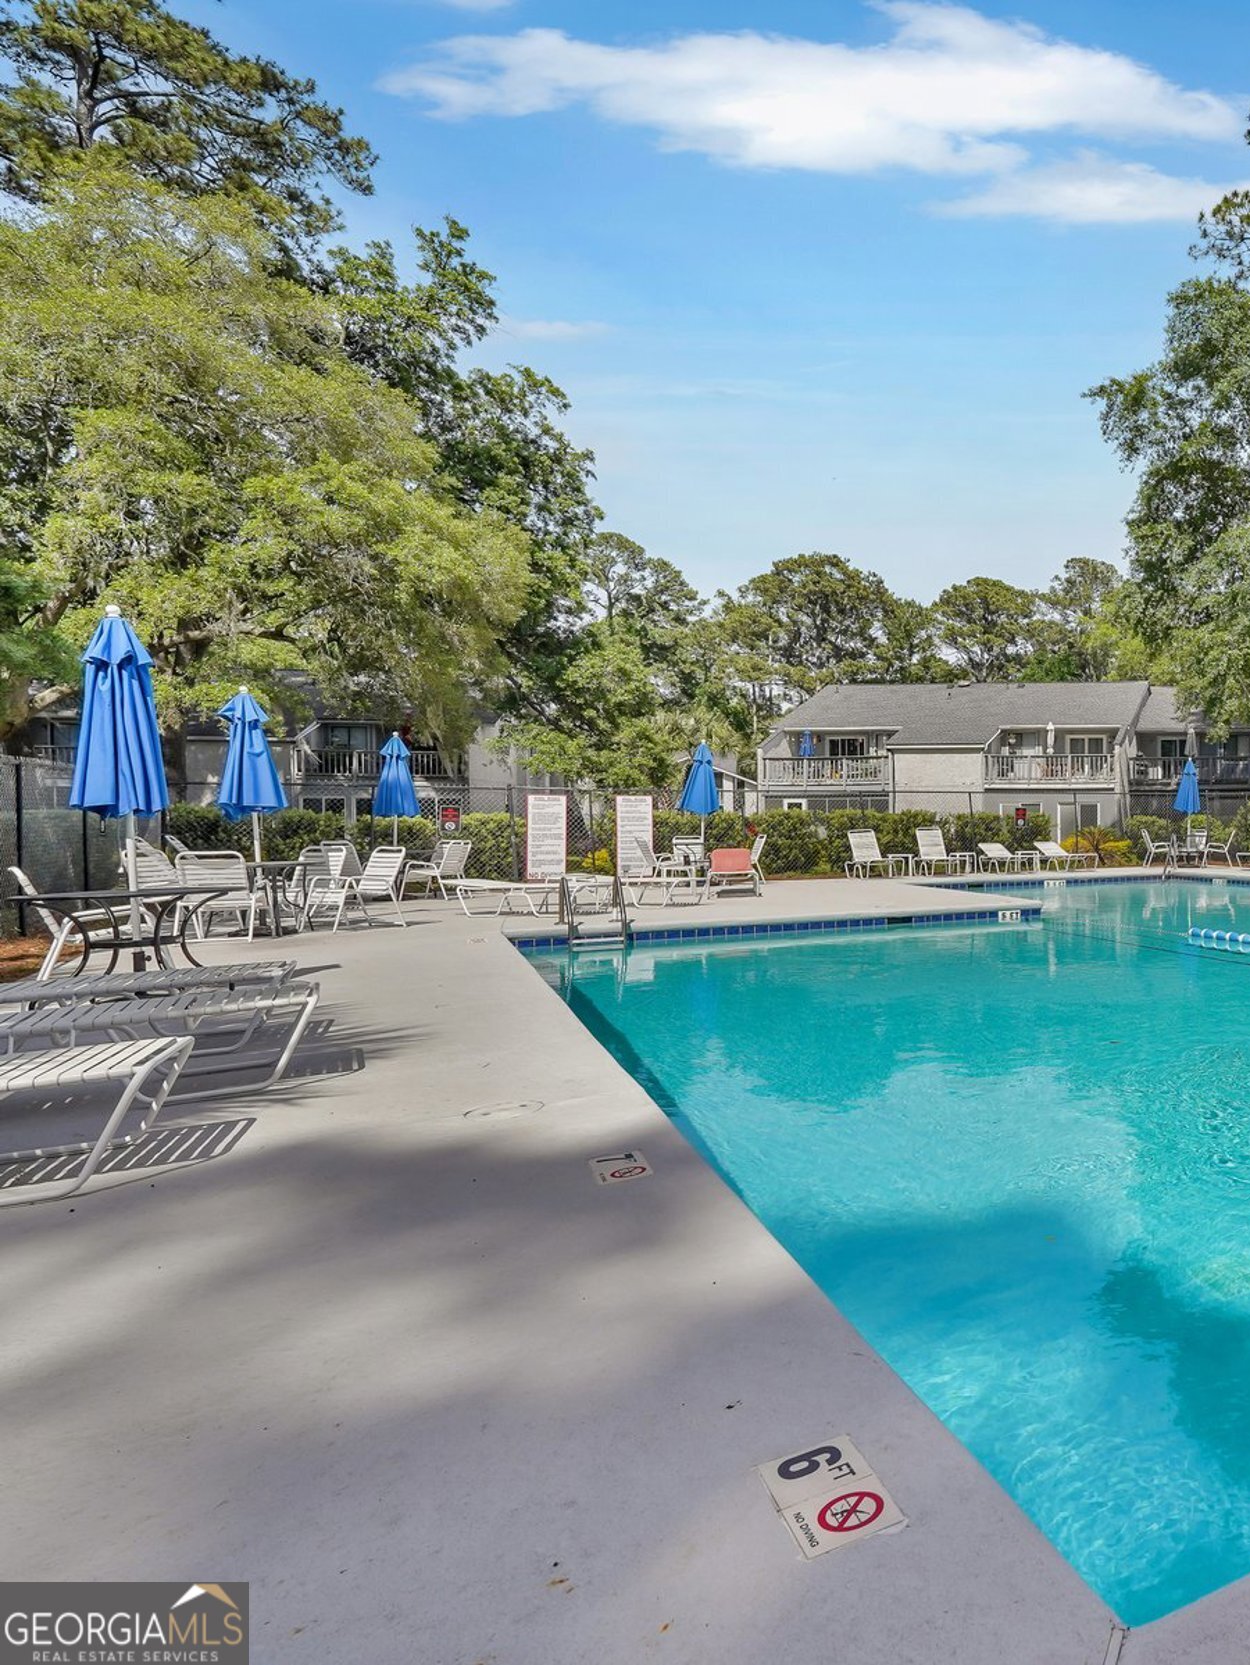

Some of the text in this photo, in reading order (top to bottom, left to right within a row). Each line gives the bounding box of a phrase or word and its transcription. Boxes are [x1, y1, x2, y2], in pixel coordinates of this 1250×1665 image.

[777, 1445, 856, 1480] 6 FT
[792, 1511, 819, 1549] NO DIVING
